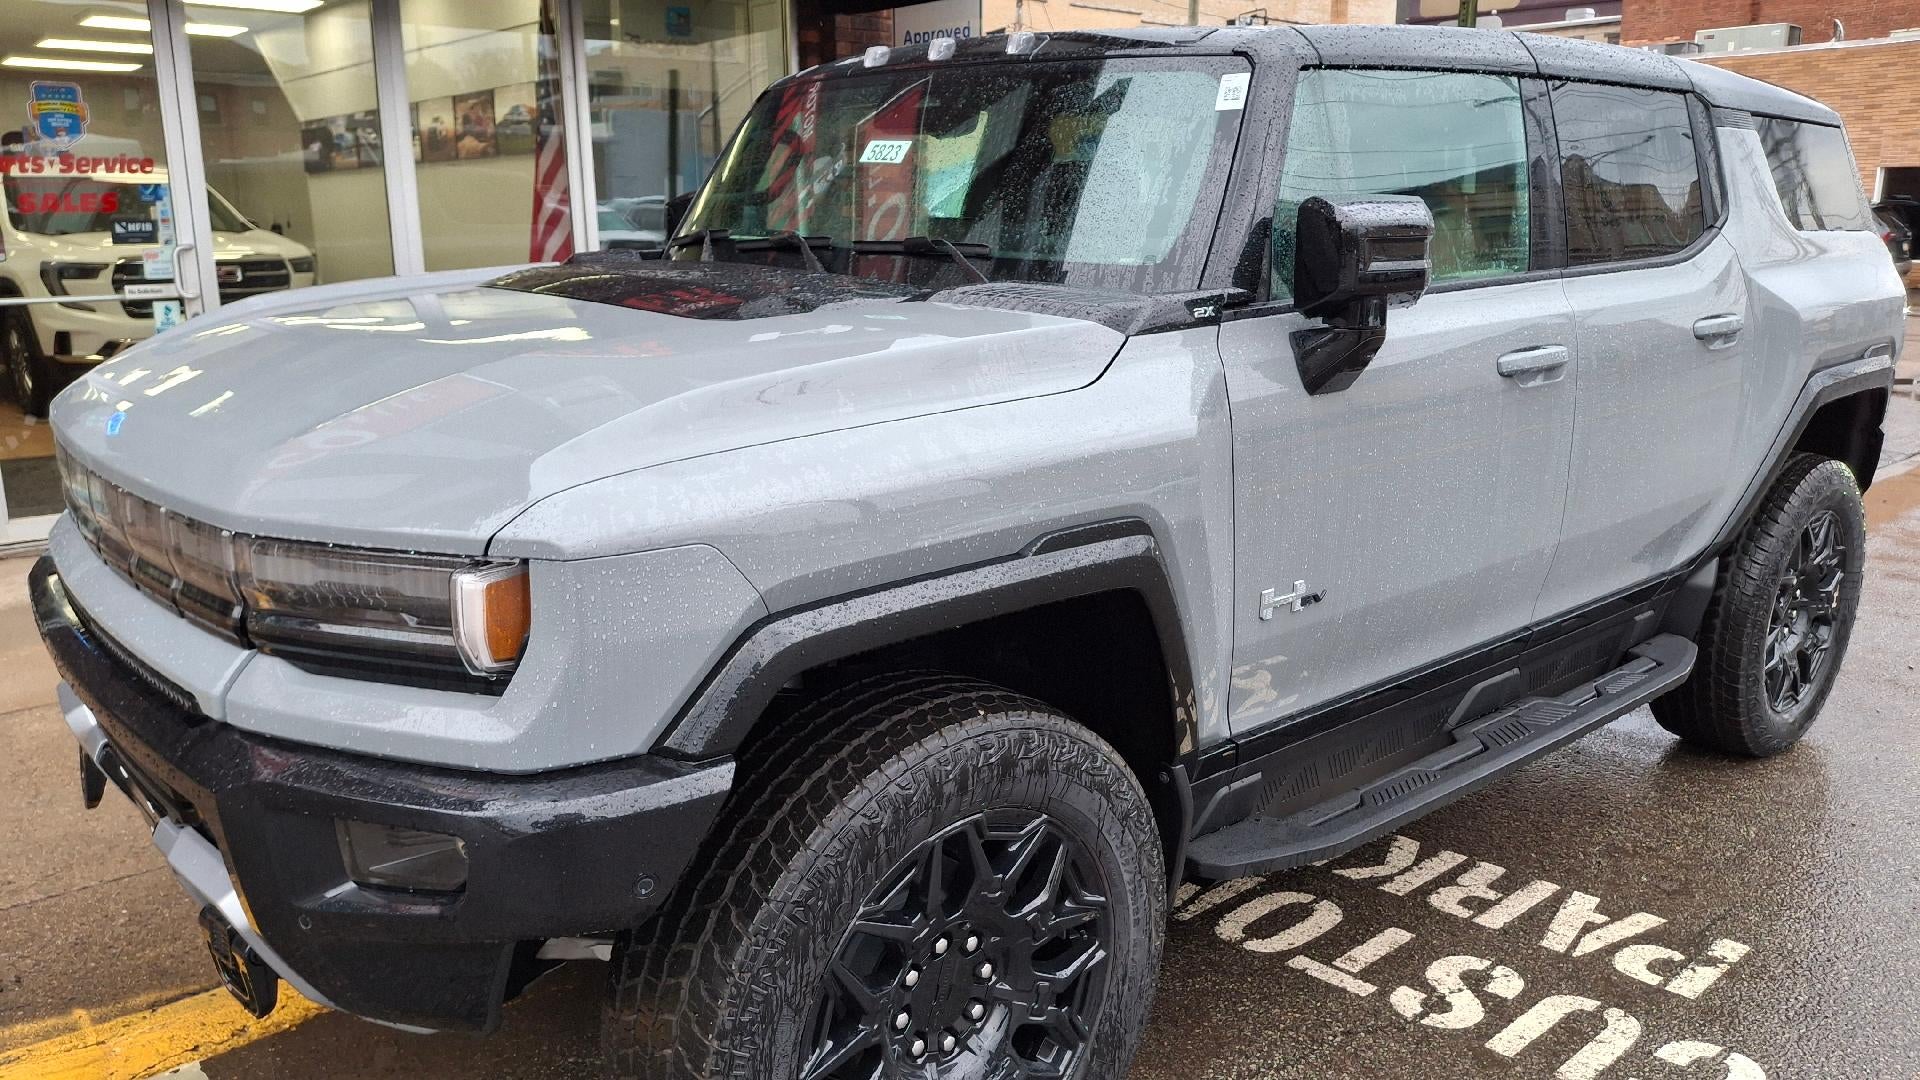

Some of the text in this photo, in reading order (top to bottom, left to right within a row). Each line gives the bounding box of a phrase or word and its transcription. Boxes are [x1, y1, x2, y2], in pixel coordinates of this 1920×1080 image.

[903, 20, 970, 45] Approved
[867, 144, 902, 161] 5823
[59, 153, 155, 174] Service
[17, 192, 119, 214] SALES
[1193, 306, 1216, 318] 2X
[1312, 835, 1751, 1000] PARK
